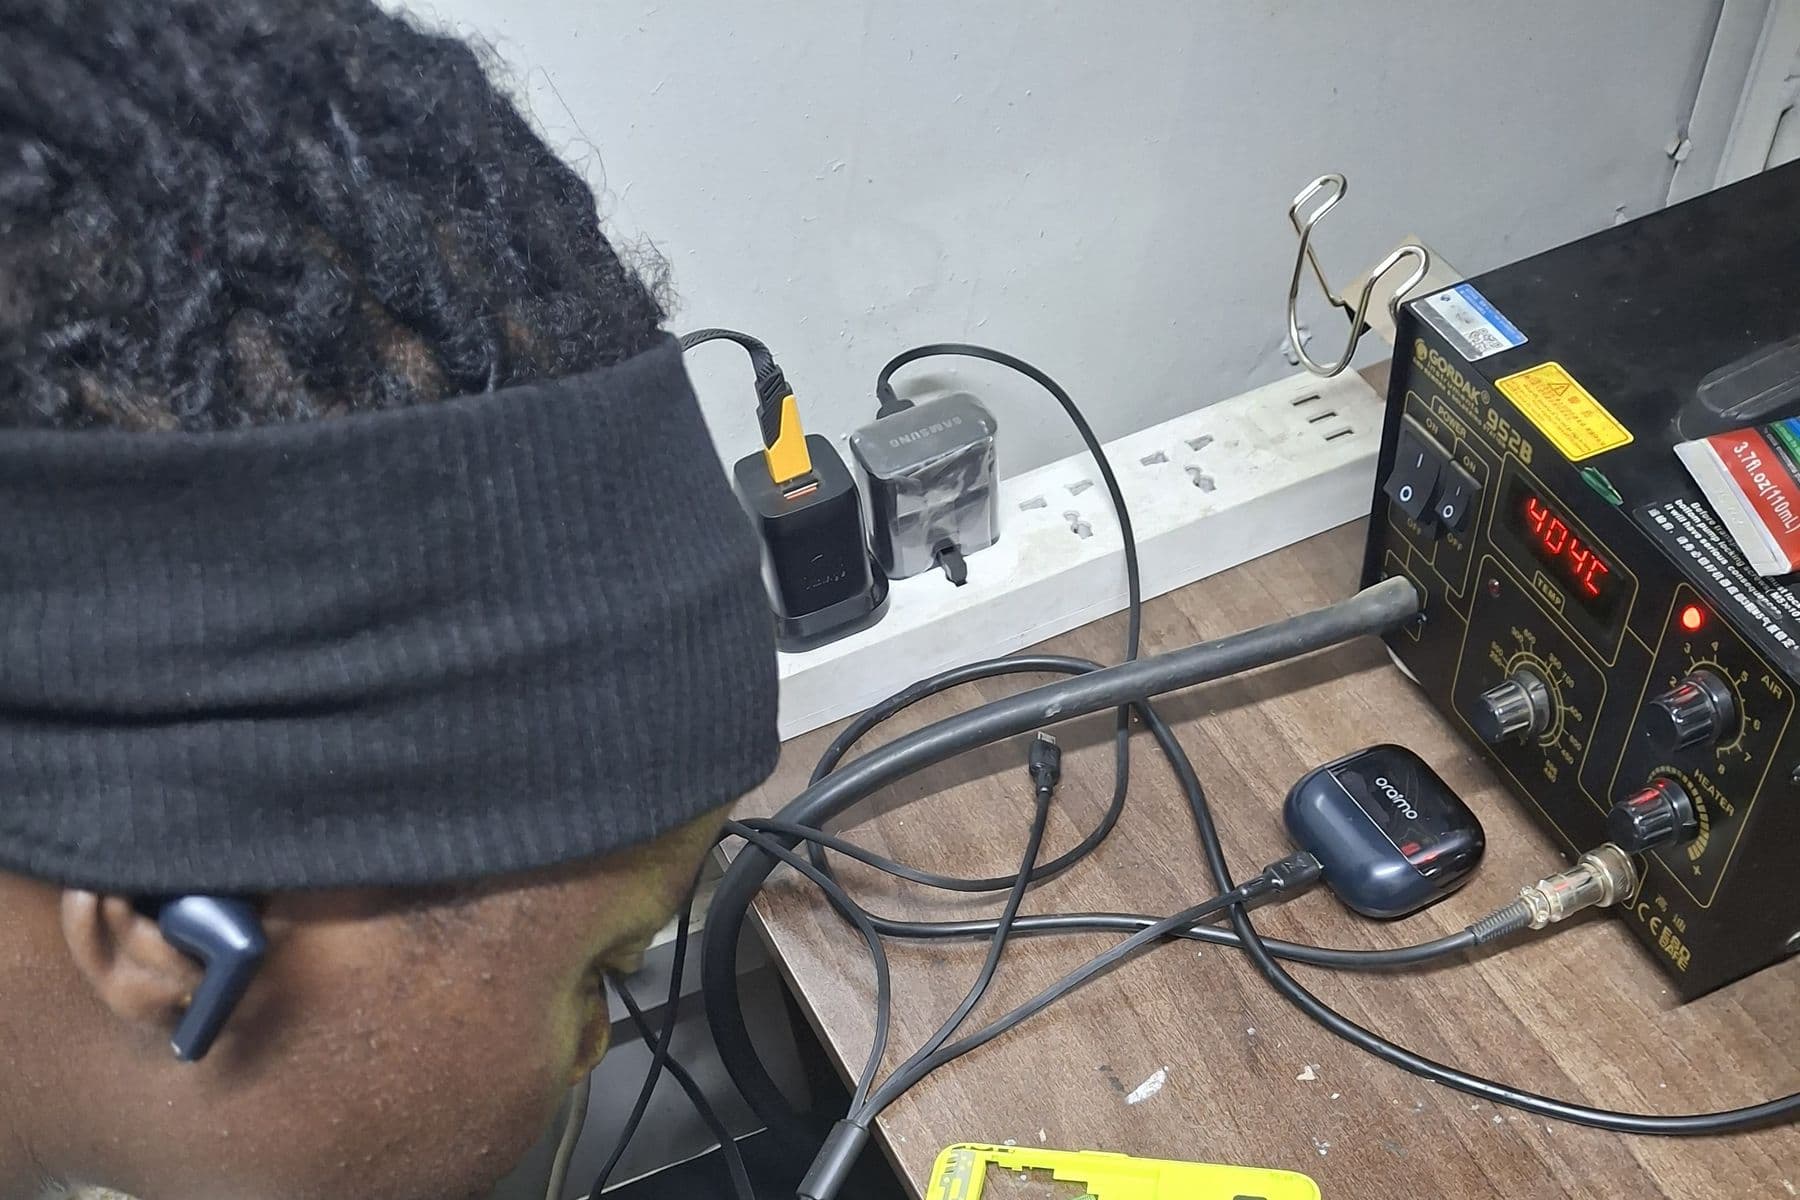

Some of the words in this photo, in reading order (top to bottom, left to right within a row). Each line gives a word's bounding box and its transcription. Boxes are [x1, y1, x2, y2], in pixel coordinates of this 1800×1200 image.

[888, 415, 963, 447] SAMSUNG
[1426, 417, 1438, 435] ON
[1438, 406, 1467, 439] POWER
[1487, 408, 1532, 465] 952B
[1463, 456, 1476, 473] ON
[1682, 520, 1702, 540] have
[1700, 538, 1728, 566] serious
[1684, 642, 1692, 654] 3
[1711, 641, 1719, 651] 4
[1670, 676, 1678, 688] 2
[1740, 670, 1748, 683] 5
[1760, 674, 1782, 699] AIR
[1753, 719, 1760, 731] 6
[1744, 752, 1752, 762] 7
[1376, 778, 1418, 819] oraimo
[1694, 768, 1734, 817] HEATER
[1659, 940, 1688, 972] SAFE
[1661, 926, 1691, 961] ESD
